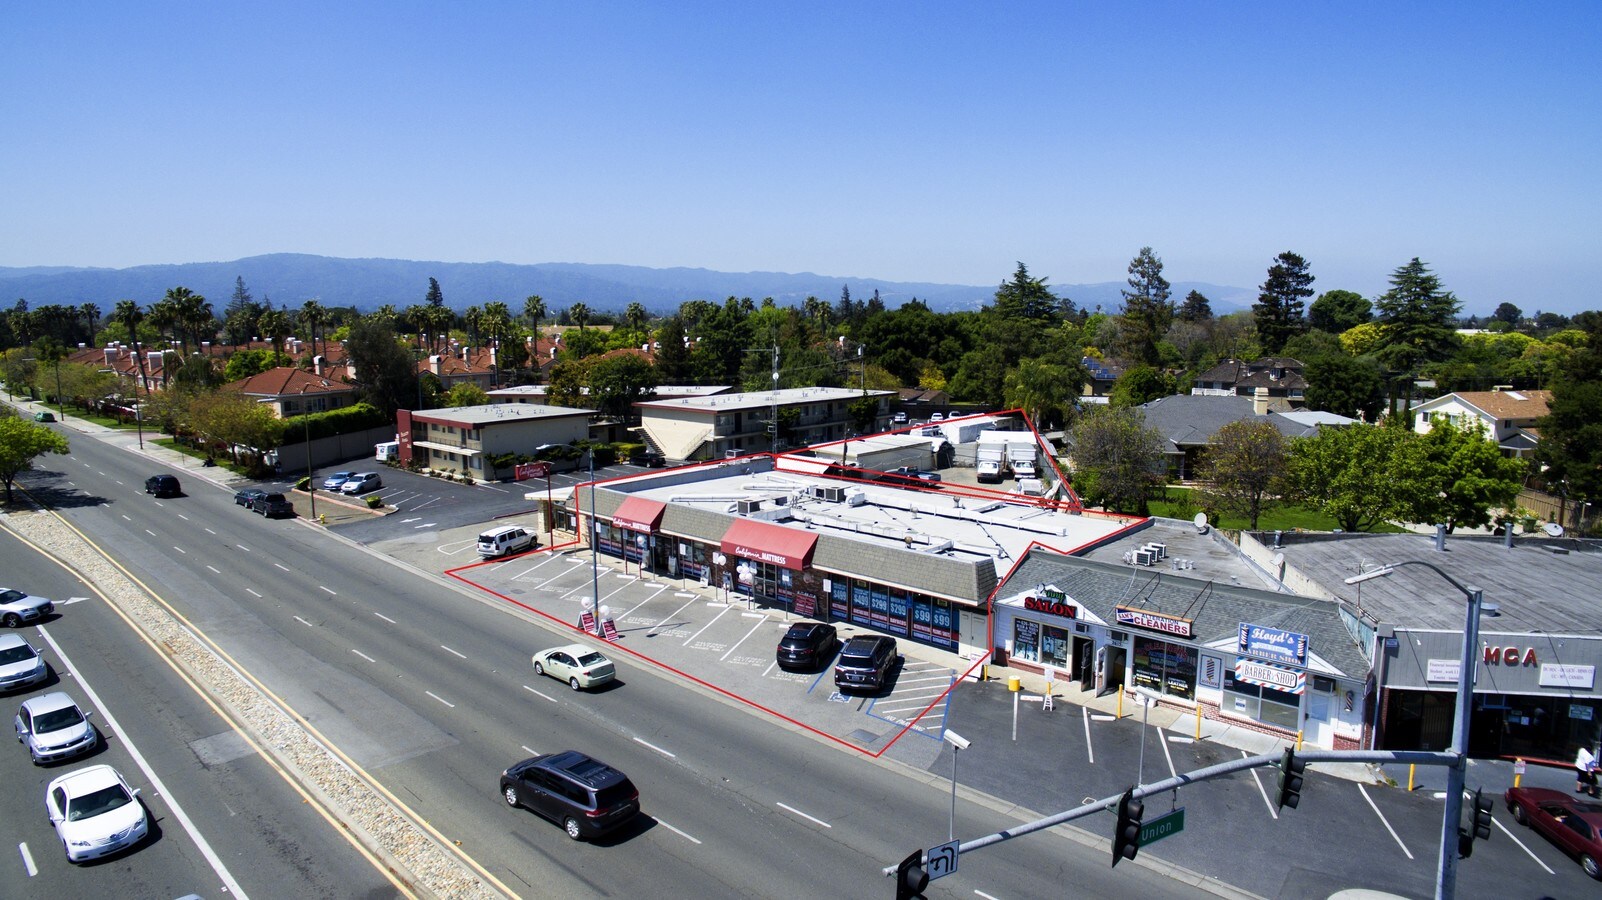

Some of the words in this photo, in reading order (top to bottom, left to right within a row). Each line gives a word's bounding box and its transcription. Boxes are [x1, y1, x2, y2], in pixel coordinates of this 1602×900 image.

[735, 547, 761, 559] California
[762, 552, 786, 565] MATTRESS
[871, 598, 887, 611] $299
[890, 603, 906, 615] $299
[1025, 597, 1076, 618] SALON
[915, 610, 930, 621] $99
[934, 614, 950, 627] $99
[1141, 613, 1179, 625] ALTERATION
[1134, 616, 1187, 635] CLEANERS
[1252, 628, 1294, 644] Floyd's
[1244, 664, 1272, 680] BARBER
[1276, 672, 1294, 686] SHOP
[1141, 822, 1172, 841] Union
